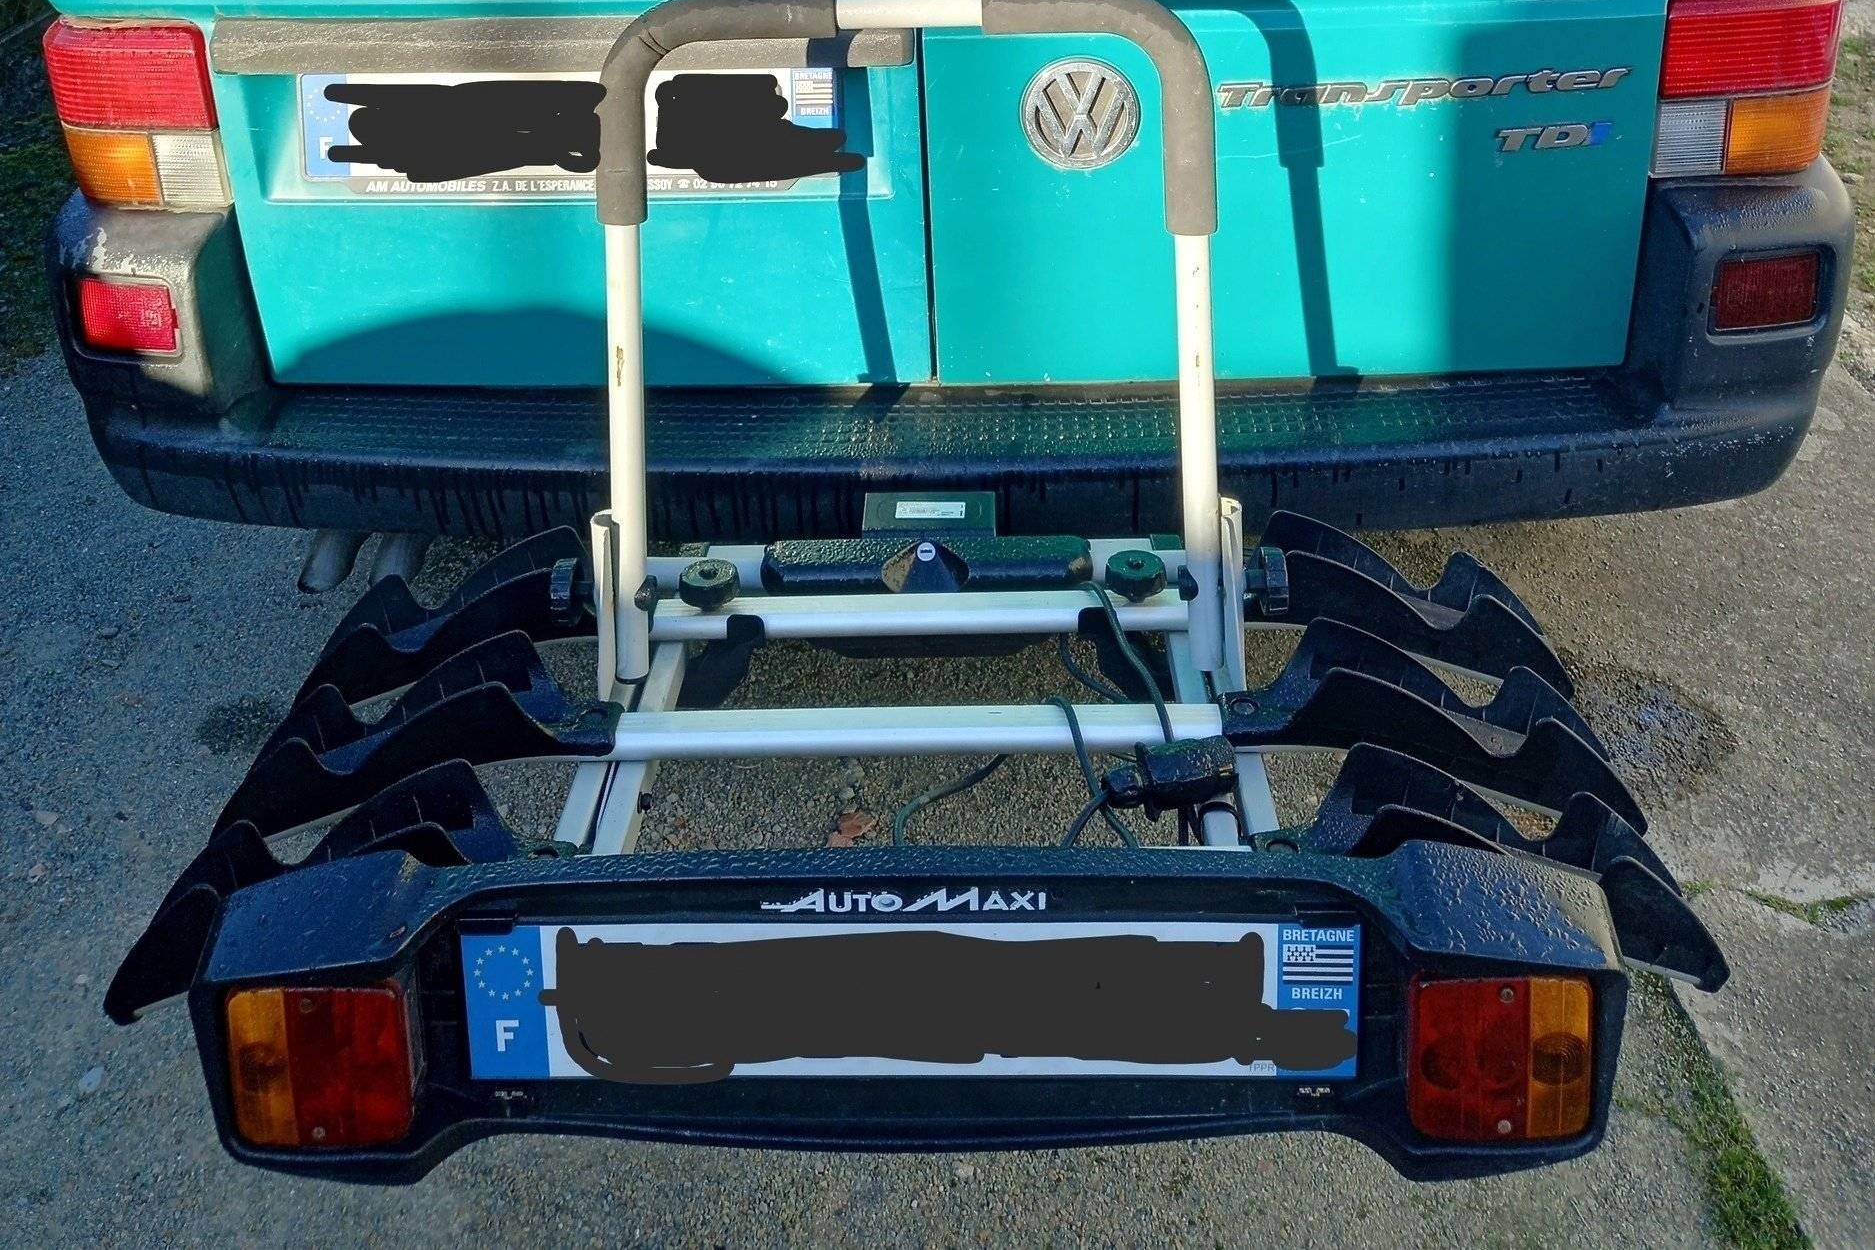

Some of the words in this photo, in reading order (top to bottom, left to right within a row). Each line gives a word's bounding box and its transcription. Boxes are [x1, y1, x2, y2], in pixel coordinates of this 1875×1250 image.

[1218, 67, 1632, 108] Transporter
[1498, 121, 1614, 152] TDI
[365, 181, 388, 192] AM
[391, 180, 487, 192] AUTOMOBILES
[516, 180, 529, 191] DE
[1282, 929, 1354, 942] BRETAGNE
[1291, 987, 1342, 1000] BREIZH
[495, 1019, 520, 1052] F
